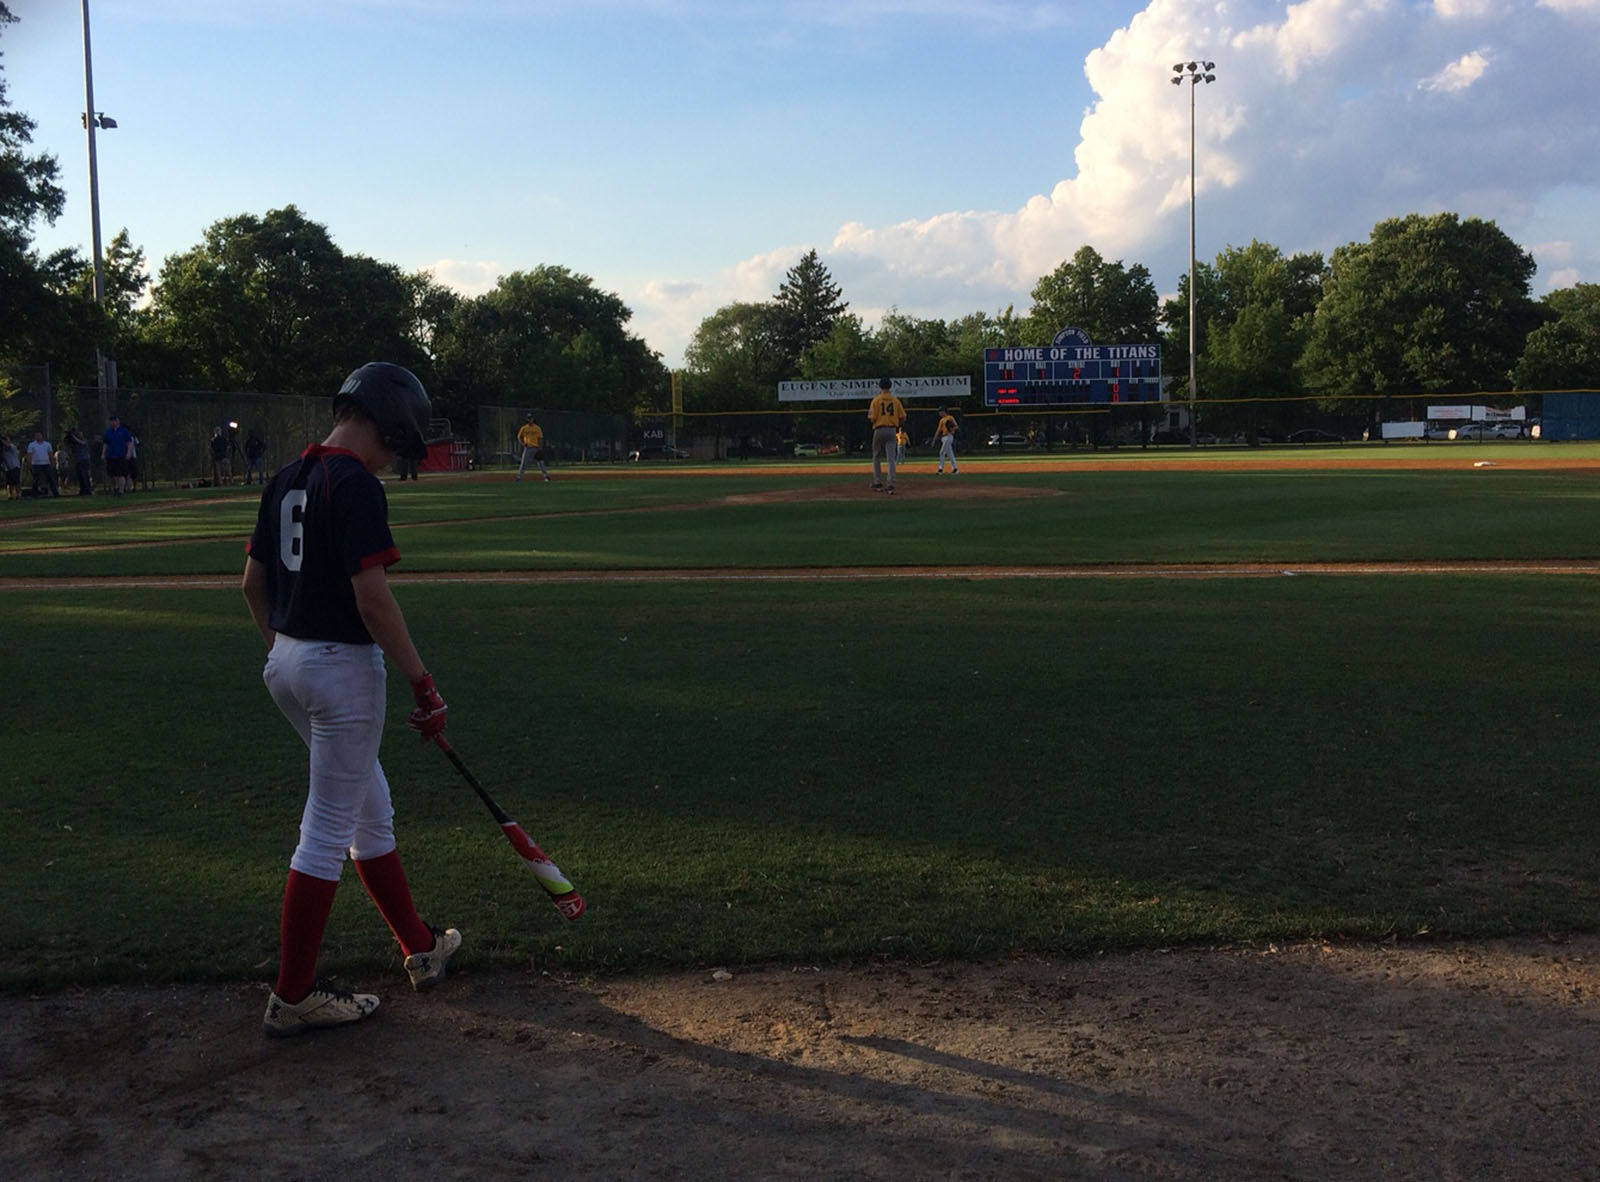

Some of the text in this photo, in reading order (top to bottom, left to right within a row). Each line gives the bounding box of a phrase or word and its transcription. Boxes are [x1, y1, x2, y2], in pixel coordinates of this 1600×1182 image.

[1004, 349, 1043, 361] HOME
[1050, 348, 1067, 360] OF
[1075, 347, 1100, 359] THE
[1107, 346, 1157, 358] TITANS
[1073, 368, 1080, 380] 2
[781, 377, 967, 391] EUGENE SIMPN STADIUM
[880, 401, 895, 416] 14
[643, 429, 664, 439] KAB
[280, 489, 308, 572] 6
